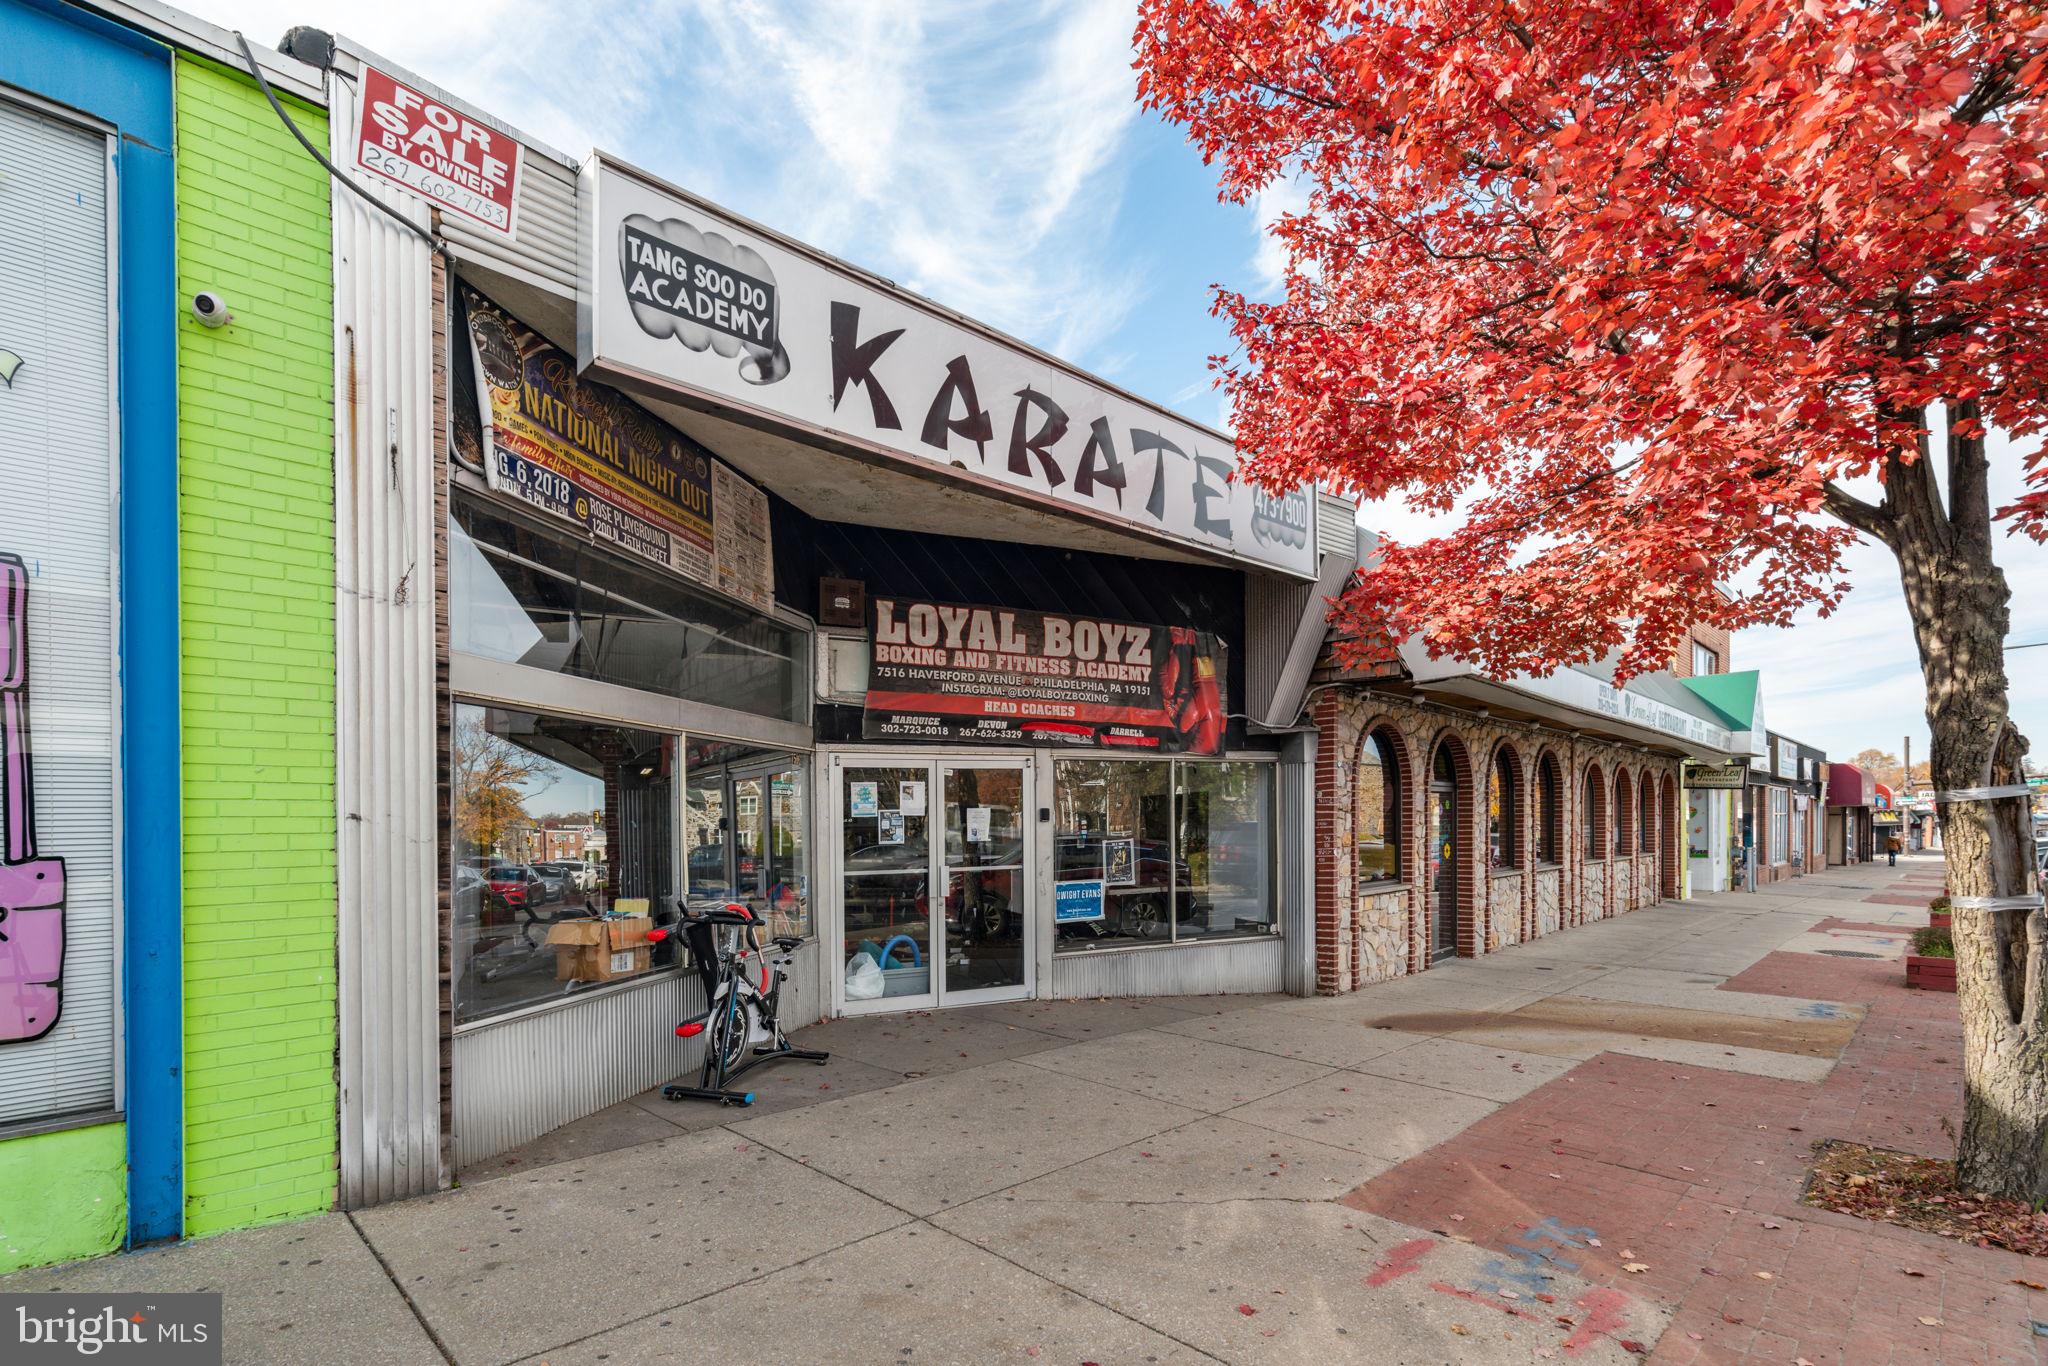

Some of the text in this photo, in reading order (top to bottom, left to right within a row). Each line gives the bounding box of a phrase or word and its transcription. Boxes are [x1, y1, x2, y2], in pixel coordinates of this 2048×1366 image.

[394, 85, 491, 152] FOR
[371, 101, 508, 188] SALE
[382, 131, 495, 199] BY OWNER
[627, 235, 767, 311] TANG SOO DO
[629, 270, 770, 340] ACADEMY
[509, 417, 529, 433] GAMES
[830, 301, 1234, 538] KARATE
[510, 432, 546, 464] family
[547, 456, 575, 479] affair
[523, 381, 709, 516] NATIONAL NIGHT OUT
[526, 489, 532, 502] 5
[589, 497, 612, 523] ROSE
[614, 510, 667, 548] PLAYGROUND
[592, 518, 612, 541] 1200
[622, 532, 640, 552] 75TH
[641, 540, 668, 564] STREET
[876, 600, 1152, 666] LOYAL BOYZ
[876, 644, 1152, 683] BOXING AND FITNESS ACADEMY
[877, 667, 1151, 696] 7516 HAVERFORD AVENUE PHILADELPHIA, PA 19151
[941, 683, 1109, 703] INSTAGRAM: @LOYALBOYZBOXING
[984, 700, 1076, 717] HEAD COACHES
[881, 724, 949, 736] 302-723-0018
[959, 728, 1022, 739] 267-626-3329
[891, 715, 1144, 737] MARQUICE DEVON DARRELL
[1056, 889, 1101, 900] DWIGHT EVANS
